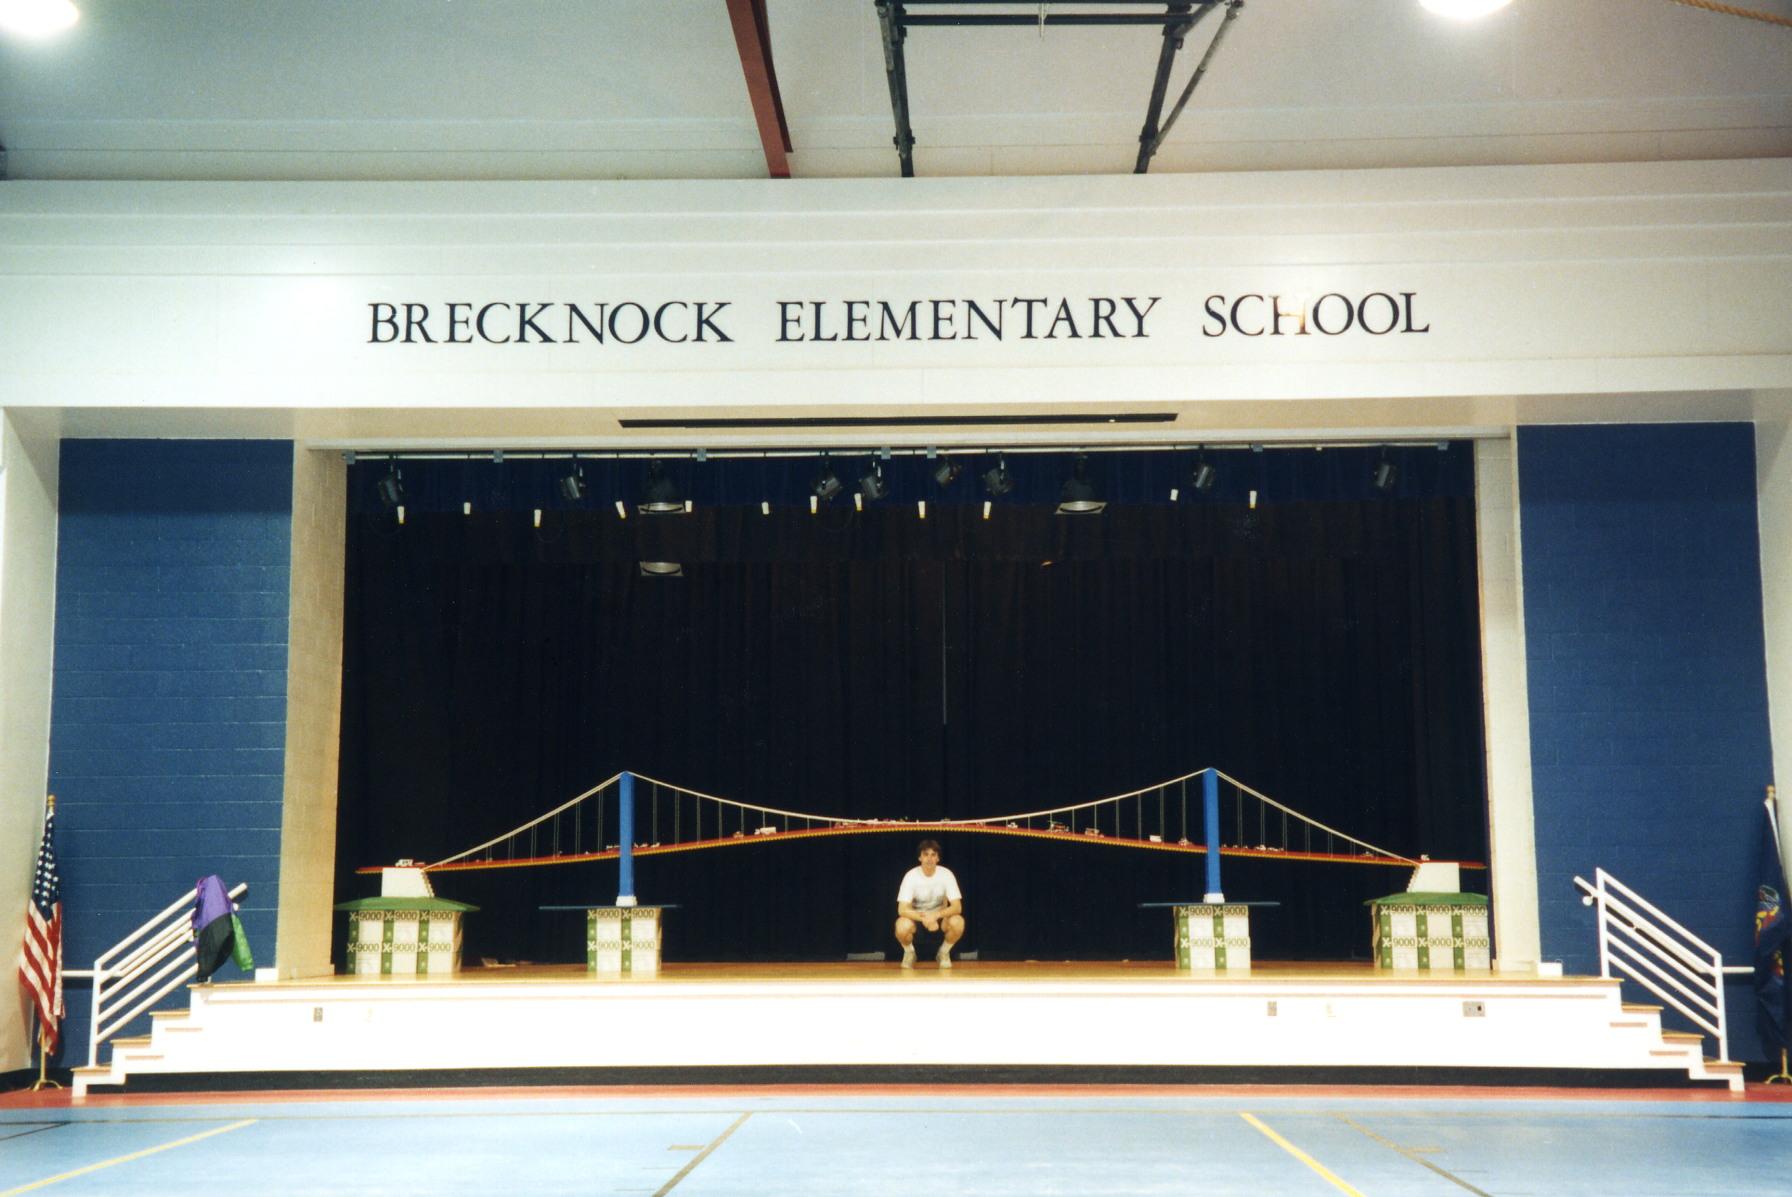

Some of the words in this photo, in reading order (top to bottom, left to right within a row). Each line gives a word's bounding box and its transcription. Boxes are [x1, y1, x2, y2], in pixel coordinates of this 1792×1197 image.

[367, 301, 734, 344] BRECKNOCK
[775, 297, 1162, 342] ELEMENTARY
[1202, 291, 1431, 337] SCHOOL
